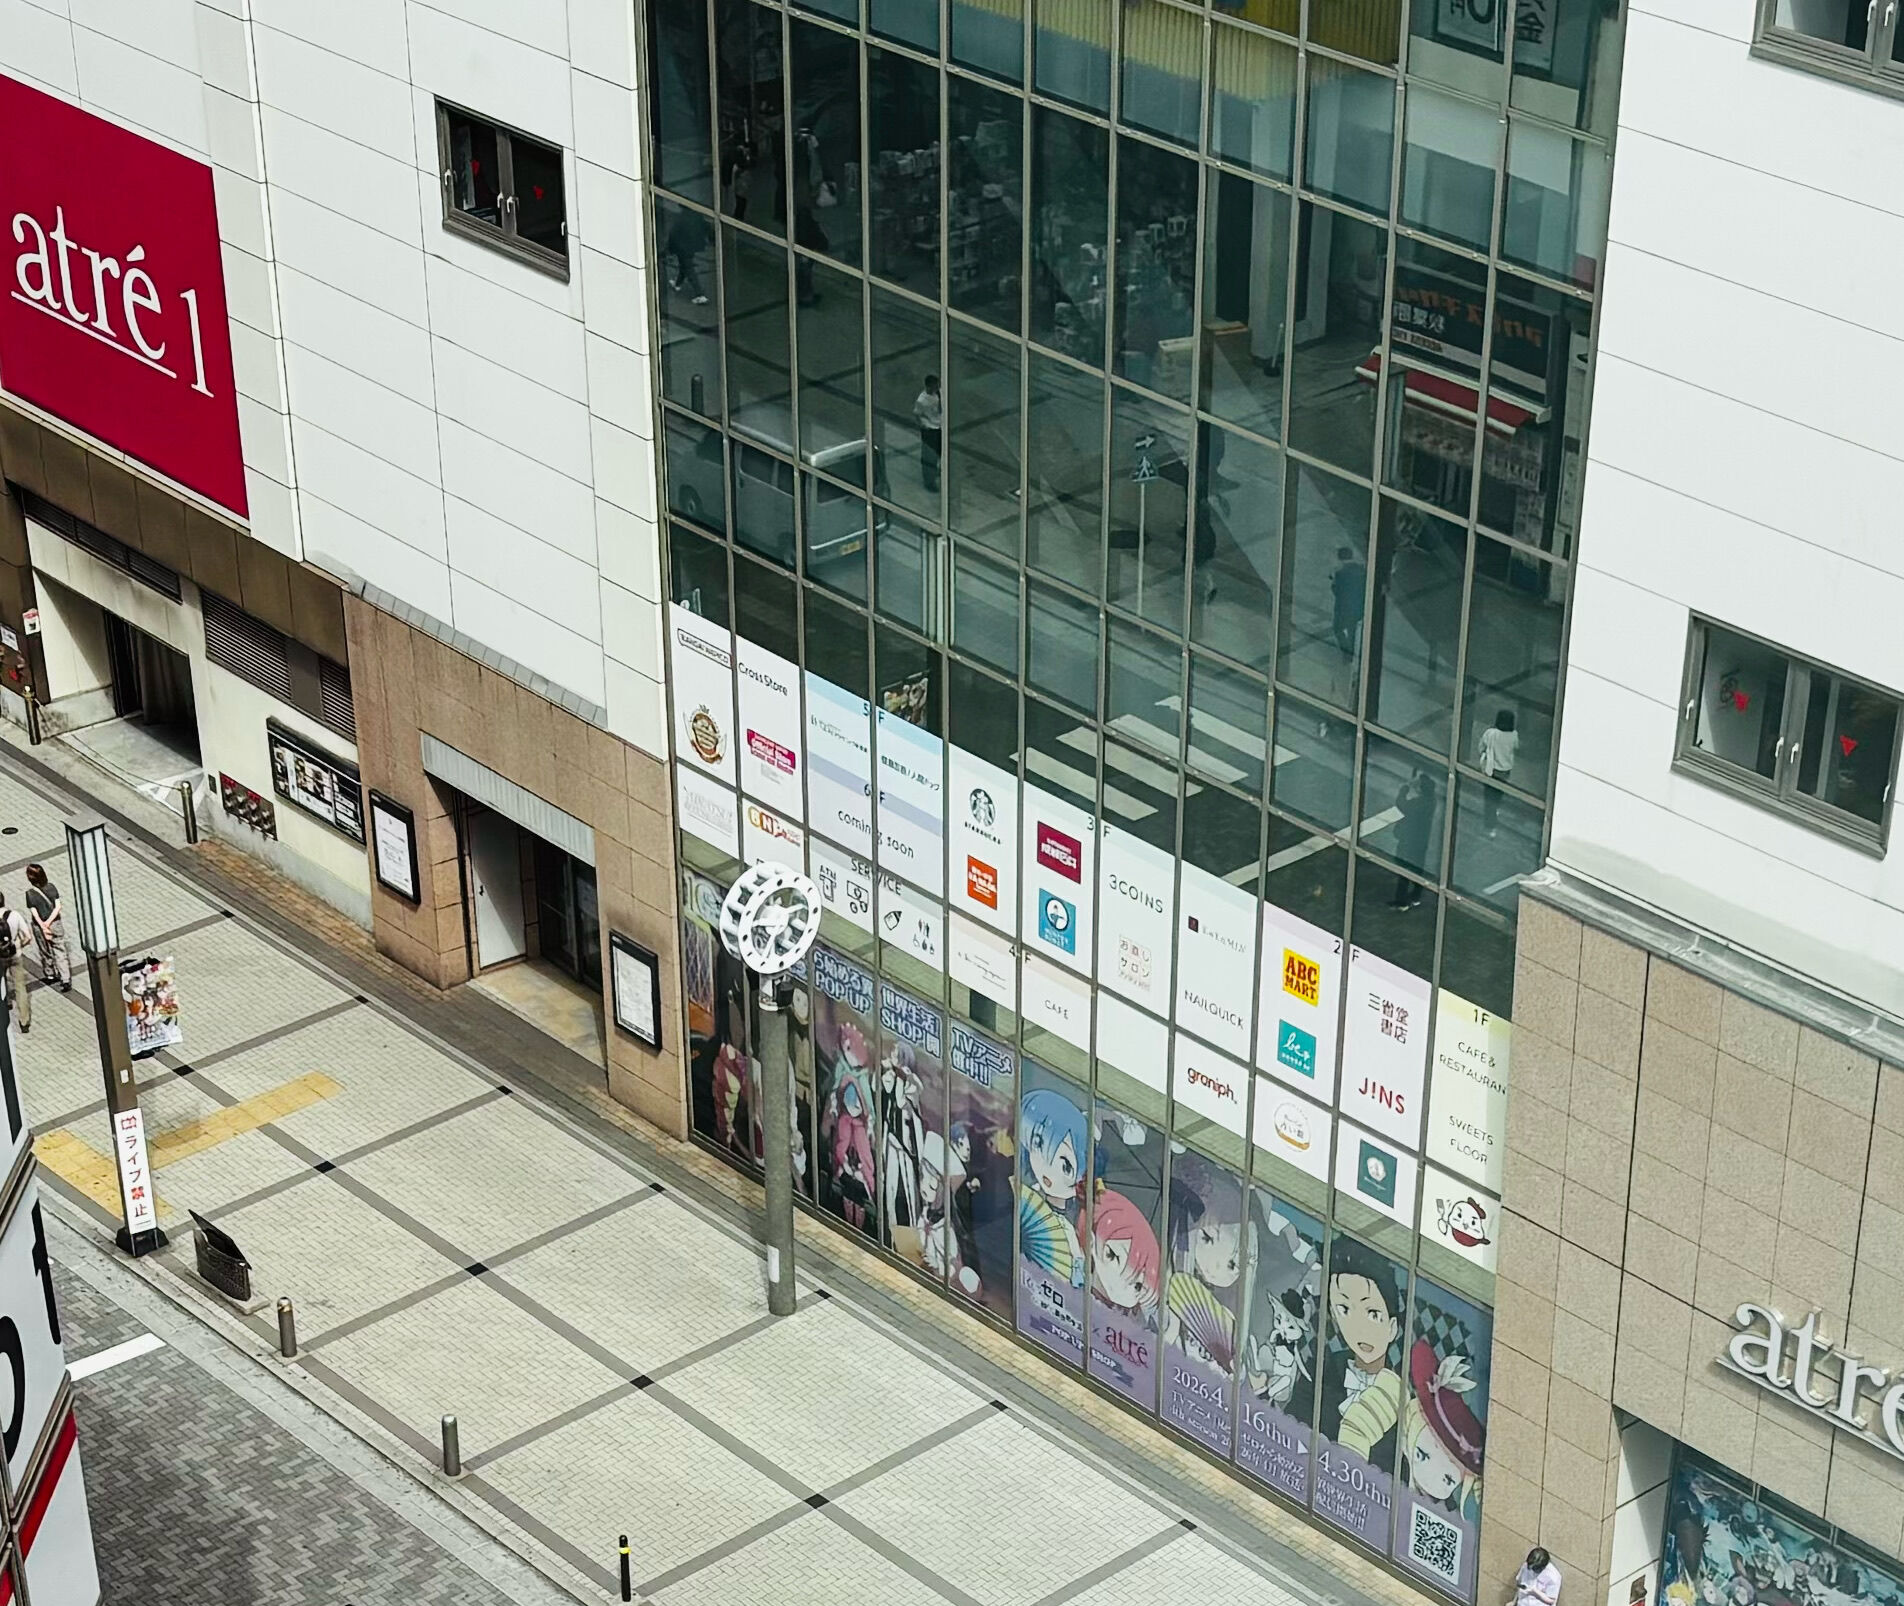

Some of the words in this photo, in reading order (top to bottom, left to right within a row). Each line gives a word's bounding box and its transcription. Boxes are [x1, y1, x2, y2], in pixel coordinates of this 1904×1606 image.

[12, 205, 166, 362] atré
[179, 288, 215, 399] 1
[886, 835, 914, 859] soon
[1109, 874, 1163, 914] 3COINS
[1285, 955, 1318, 987] ABC
[1285, 975, 1317, 1001] MART
[1044, 999, 1069, 1020] CAFE
[1183, 989, 1245, 1030] NAILQUICK
[1368, 992, 1410, 1026] 三省堂
[1472, 1007, 1491, 1027] 1F
[1380, 1017, 1408, 1045] 書店
[1438, 1053, 1508, 1096] RESTAURAN
[1448, 1115, 1494, 1146] SWEETS
[1449, 1138, 1490, 1166] FLOOR
[1319, 1450, 1392, 1510] 4.30thu
